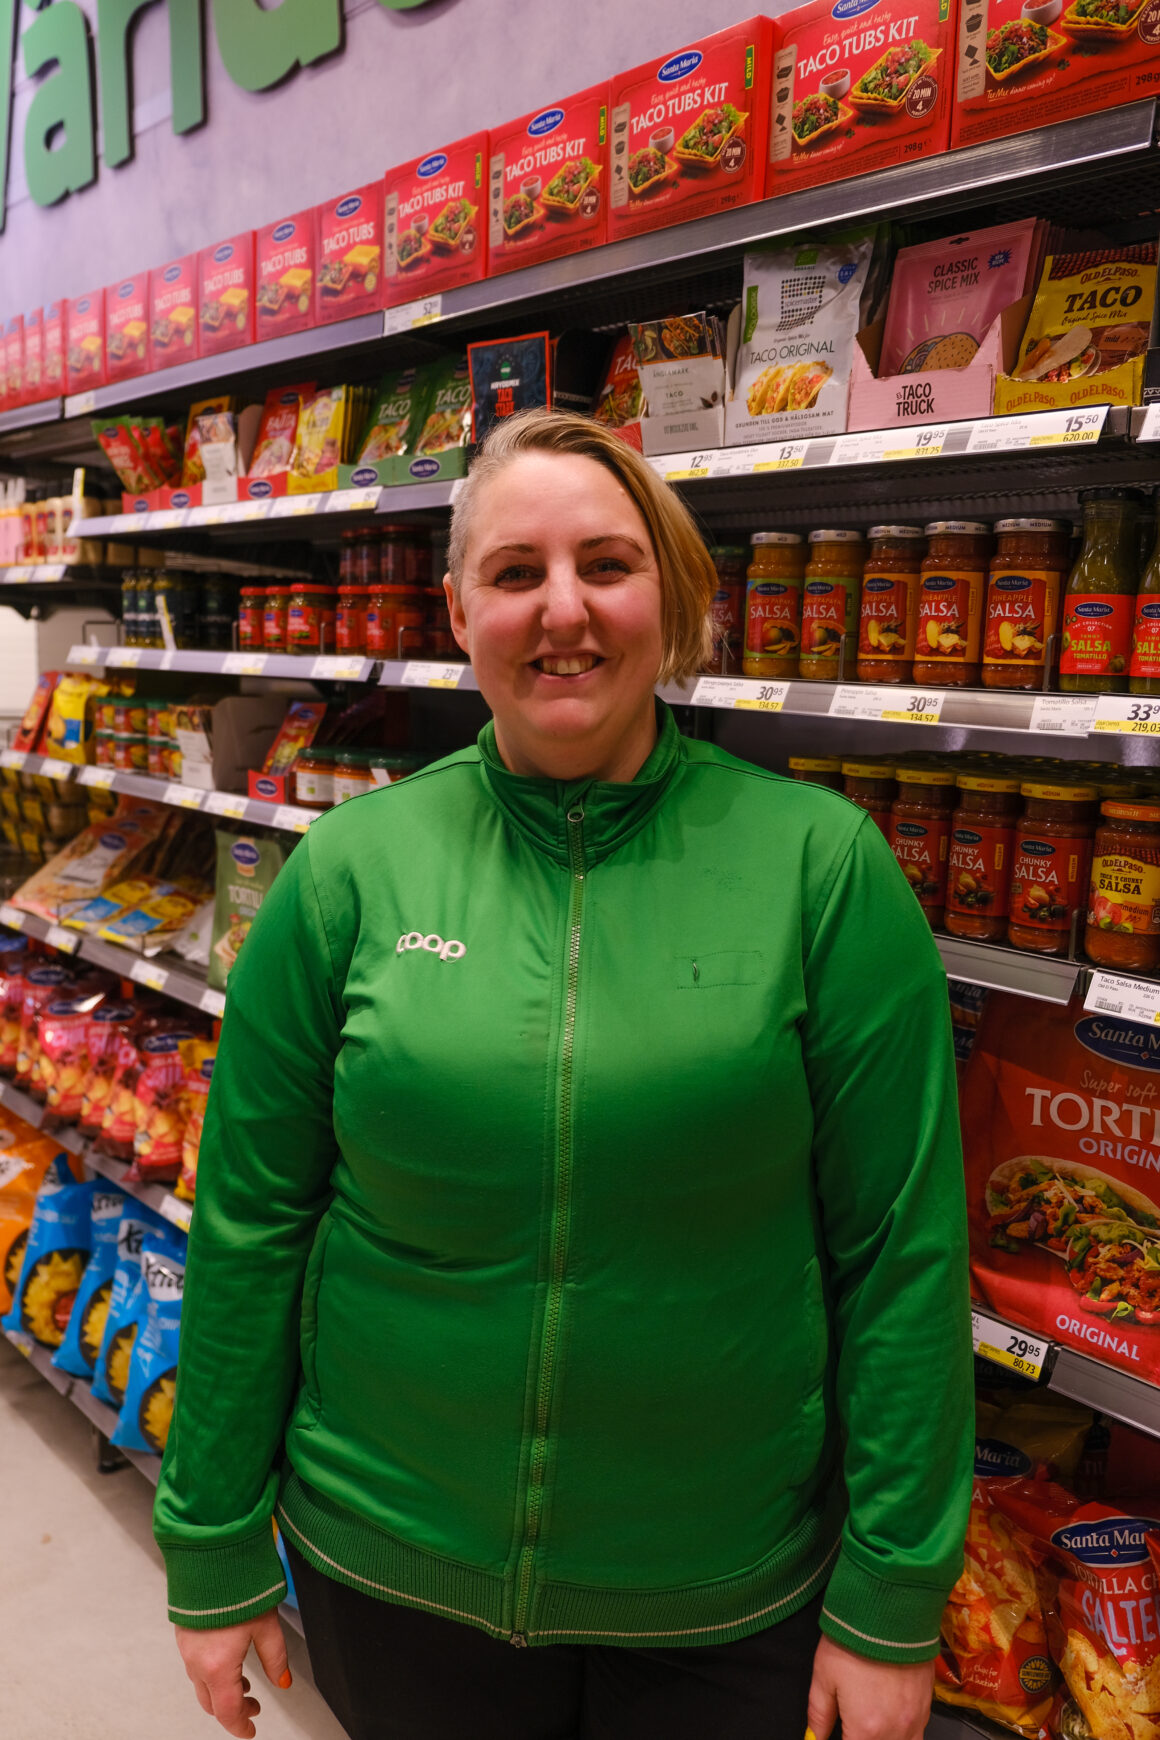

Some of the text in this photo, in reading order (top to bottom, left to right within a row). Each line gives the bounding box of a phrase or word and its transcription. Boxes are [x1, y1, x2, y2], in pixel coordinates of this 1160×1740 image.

[797, 16, 919, 80] TACO TUBS KIT
[661, 54, 699, 77] Santa Maria
[631, 82, 728, 135] TACO TUBS KIT
[505, 156, 535, 182] TACO
[535, 143, 564, 168] TUBS
[564, 138, 586, 159] KIT
[398, 194, 424, 219] TACO
[423, 184, 447, 207] TUBS
[447, 180, 465, 199] KIT
[323, 221, 374, 254] TACO TUBS
[933, 257, 979, 278] CLASSIC
[927, 272, 980, 294] SPICE MIX
[1064, 284, 1143, 314] TACO
[1109, 310, 1128, 319] Mix
[750, 339, 835, 365] TACO ORIGINAL
[435, 385, 471, 406] TACO
[665, 390, 684, 399] TACO
[902, 382, 932, 400] TACO
[1070, 388, 1089, 405] OLD
[378, 400, 411, 418] TACO
[896, 398, 935, 417] TRUCK
[1006, 396, 1024, 412] OLD
[750, 605, 791, 619] SALSA
[802, 605, 837, 619] SALSA
[861, 603, 898, 618] SALSA
[919, 602, 959, 618] SALSA
[989, 602, 1035, 619] SALSA
[1071, 640, 1111, 652] SALSA
[1073, 652, 1108, 660] TOMATILLO
[895, 838, 925, 848] CHUNKY
[952, 845, 979, 855] CHUNKY
[1019, 856, 1052, 868] CHUNKY
[1102, 858, 1114, 868] OLD
[1014, 864, 1059, 885] SALSA
[1120, 876, 1143, 885] CHUNKY
[1098, 879, 1142, 896] SALSA
[1122, 905, 1150, 916] medium
[396, 931, 467, 961] coop
[1100, 976, 1160, 995] Taco Salsa Medium
[1088, 1021, 1145, 1048] Santa
[1079, 1069, 1159, 1106] Super soft
[1025, 1087, 1160, 1148] TORTI
[1079, 1137, 1160, 1173] ORIGIN
[1055, 1314, 1141, 1361] ORIGINAL
[976, 1446, 1021, 1468] Maria
[1061, 1529, 1145, 1549] Santa Mar
[1071, 1560, 1138, 1595] TORTILLA
